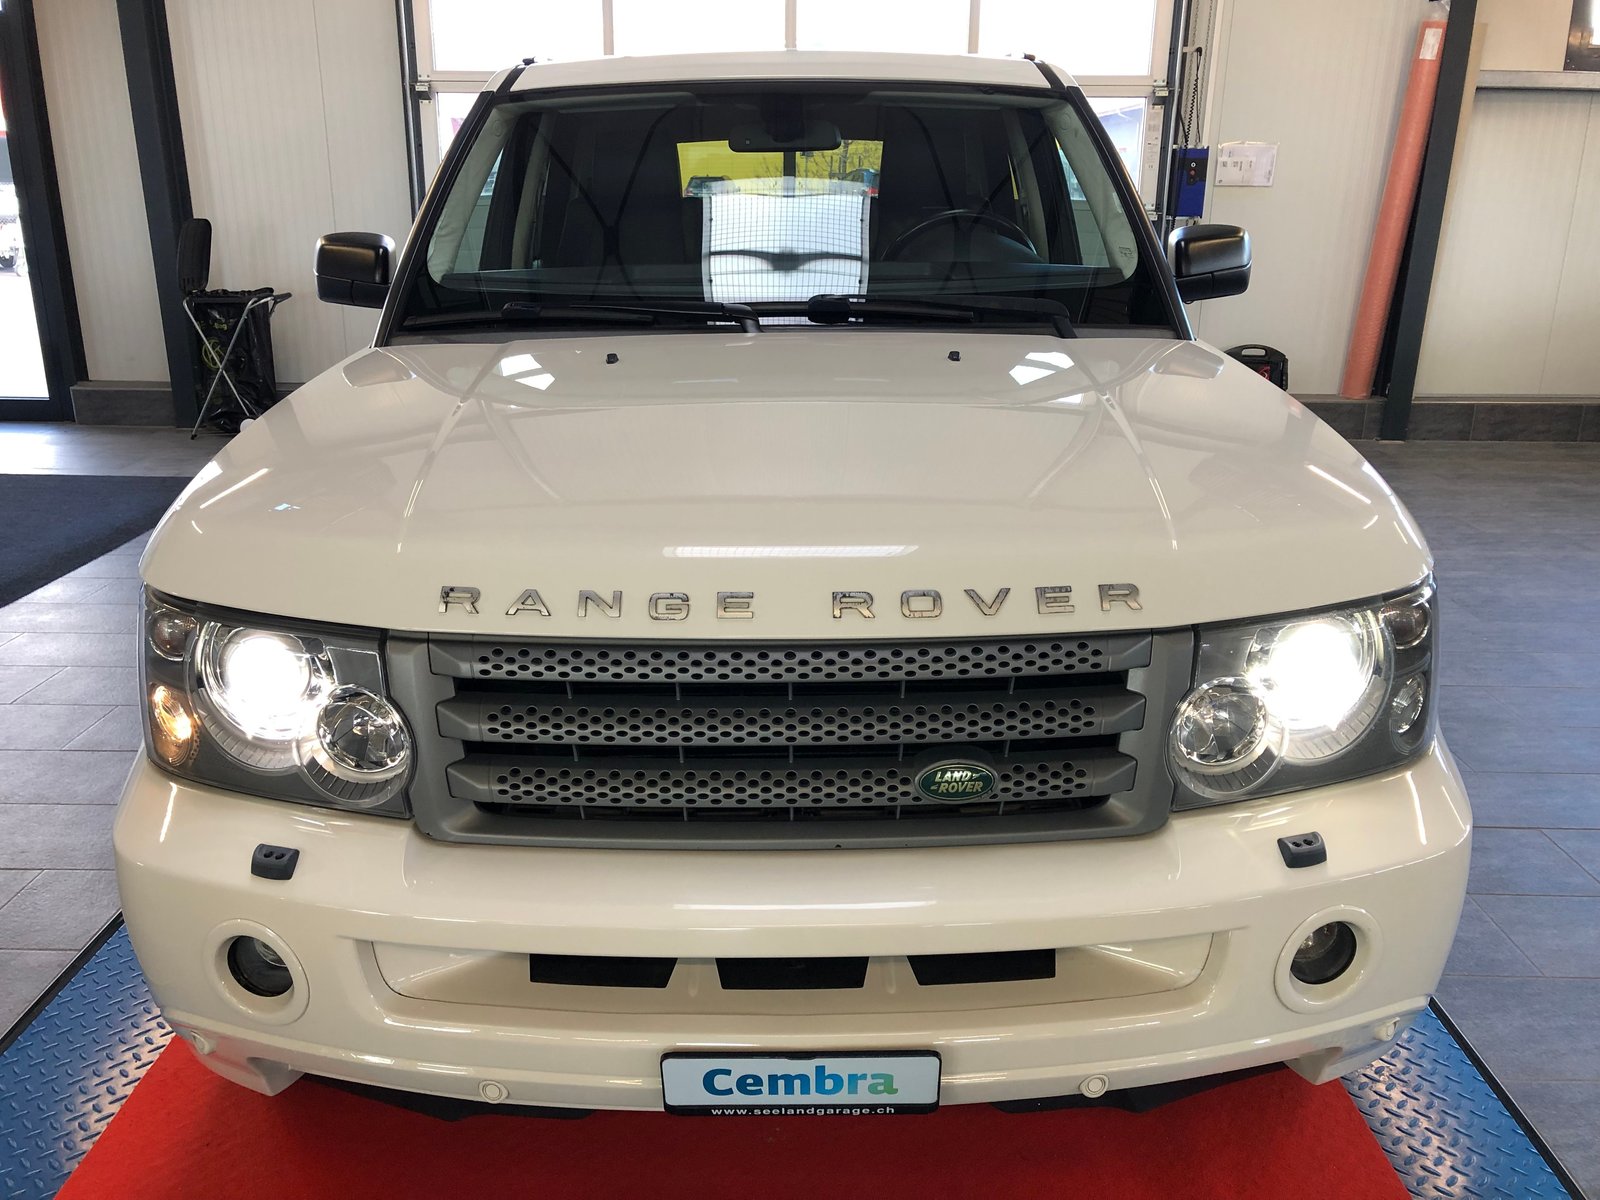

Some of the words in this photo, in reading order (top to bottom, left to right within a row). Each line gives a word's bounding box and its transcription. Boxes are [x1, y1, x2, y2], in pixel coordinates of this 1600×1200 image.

[438, 585, 755, 621] RANGE
[832, 583, 1143, 619] ROVER
[934, 770, 972, 782] LAND
[938, 781, 984, 793] ROVER
[702, 1065, 898, 1096] Cembra
[711, 1106, 895, 1116] www.seelandgarage.ch
